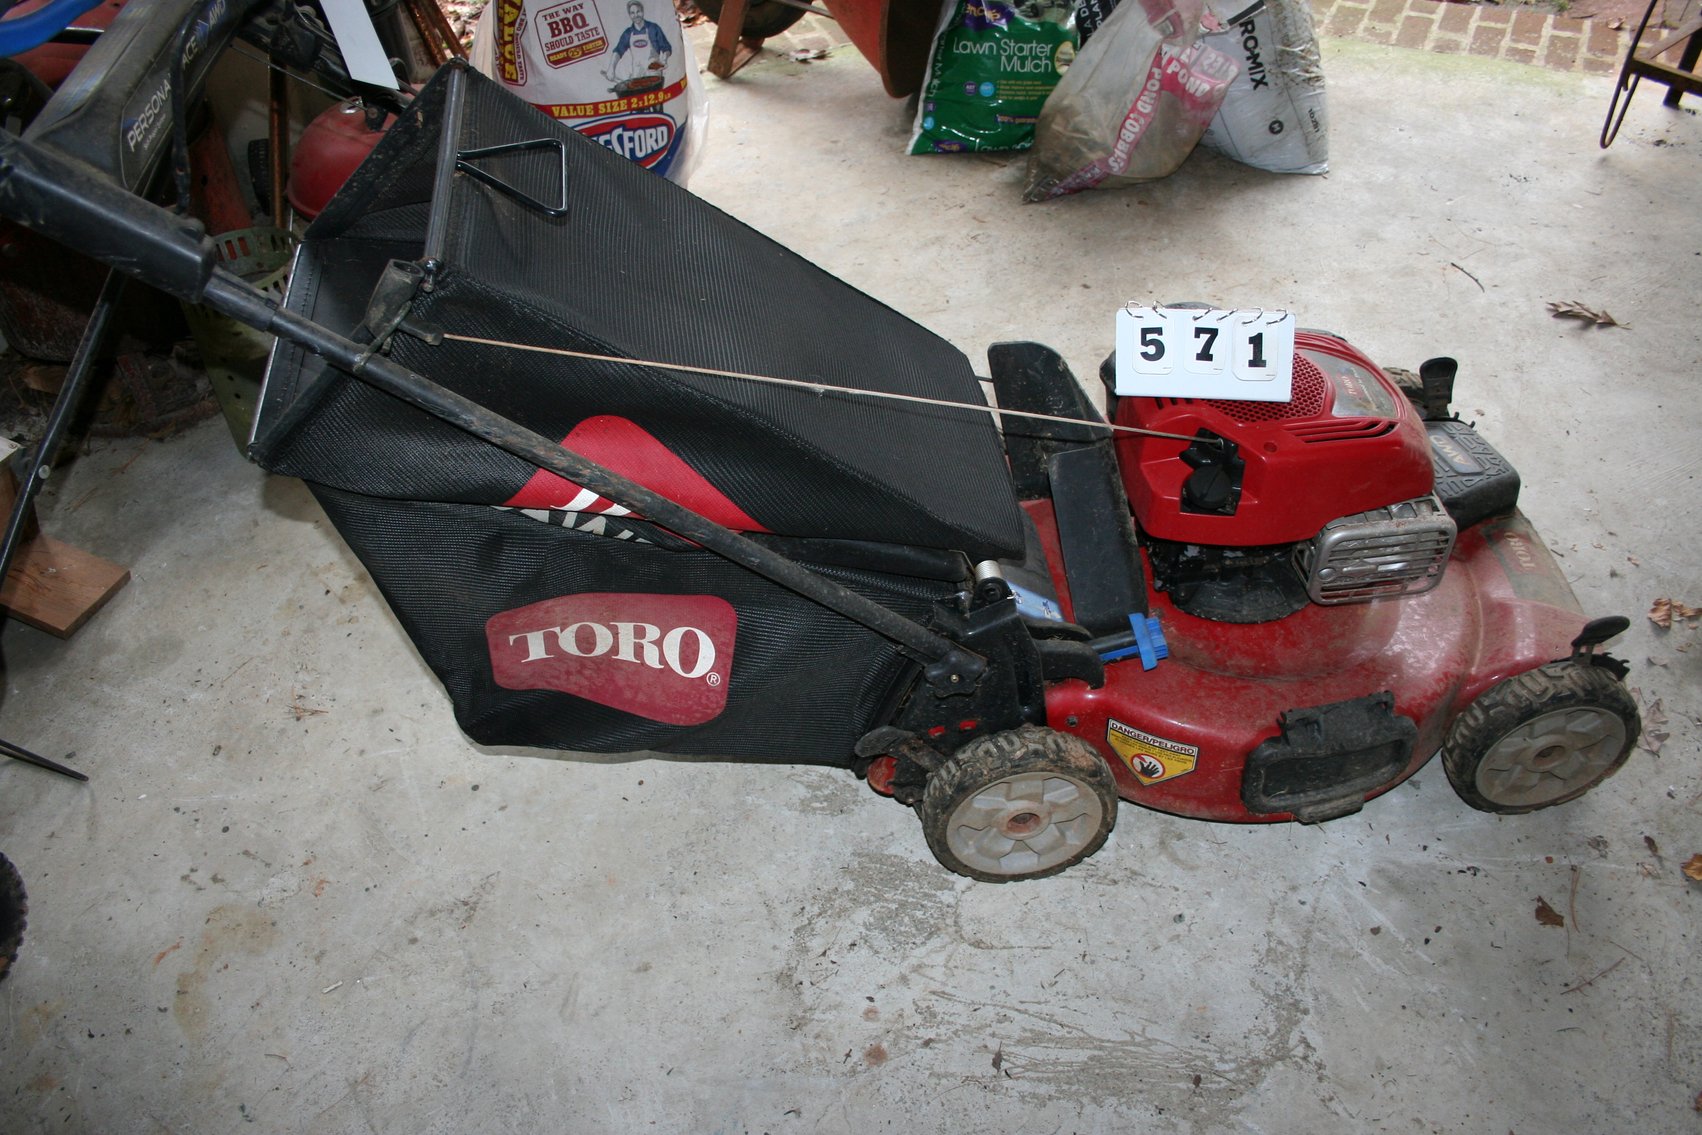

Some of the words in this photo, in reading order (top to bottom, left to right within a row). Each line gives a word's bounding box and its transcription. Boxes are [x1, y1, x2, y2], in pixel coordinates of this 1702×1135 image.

[542, 13, 561, 21] THE
[562, 3, 584, 15] WAY
[547, 12, 590, 39] BBQ
[544, 37, 574, 52] SHOULD
[574, 27, 601, 42] TASTE
[953, 37, 997, 56] Lawn
[1000, 38, 1053, 57] Starter
[1000, 55, 1051, 73] Mulch
[1136, 66, 1162, 114] POND
[1166, 58, 1211, 98] POND
[126, 72, 172, 153] PERSONA
[551, 104, 595, 117] VALUE
[598, 100, 628, 114] SIZE
[509, 621, 716, 679] TORO
